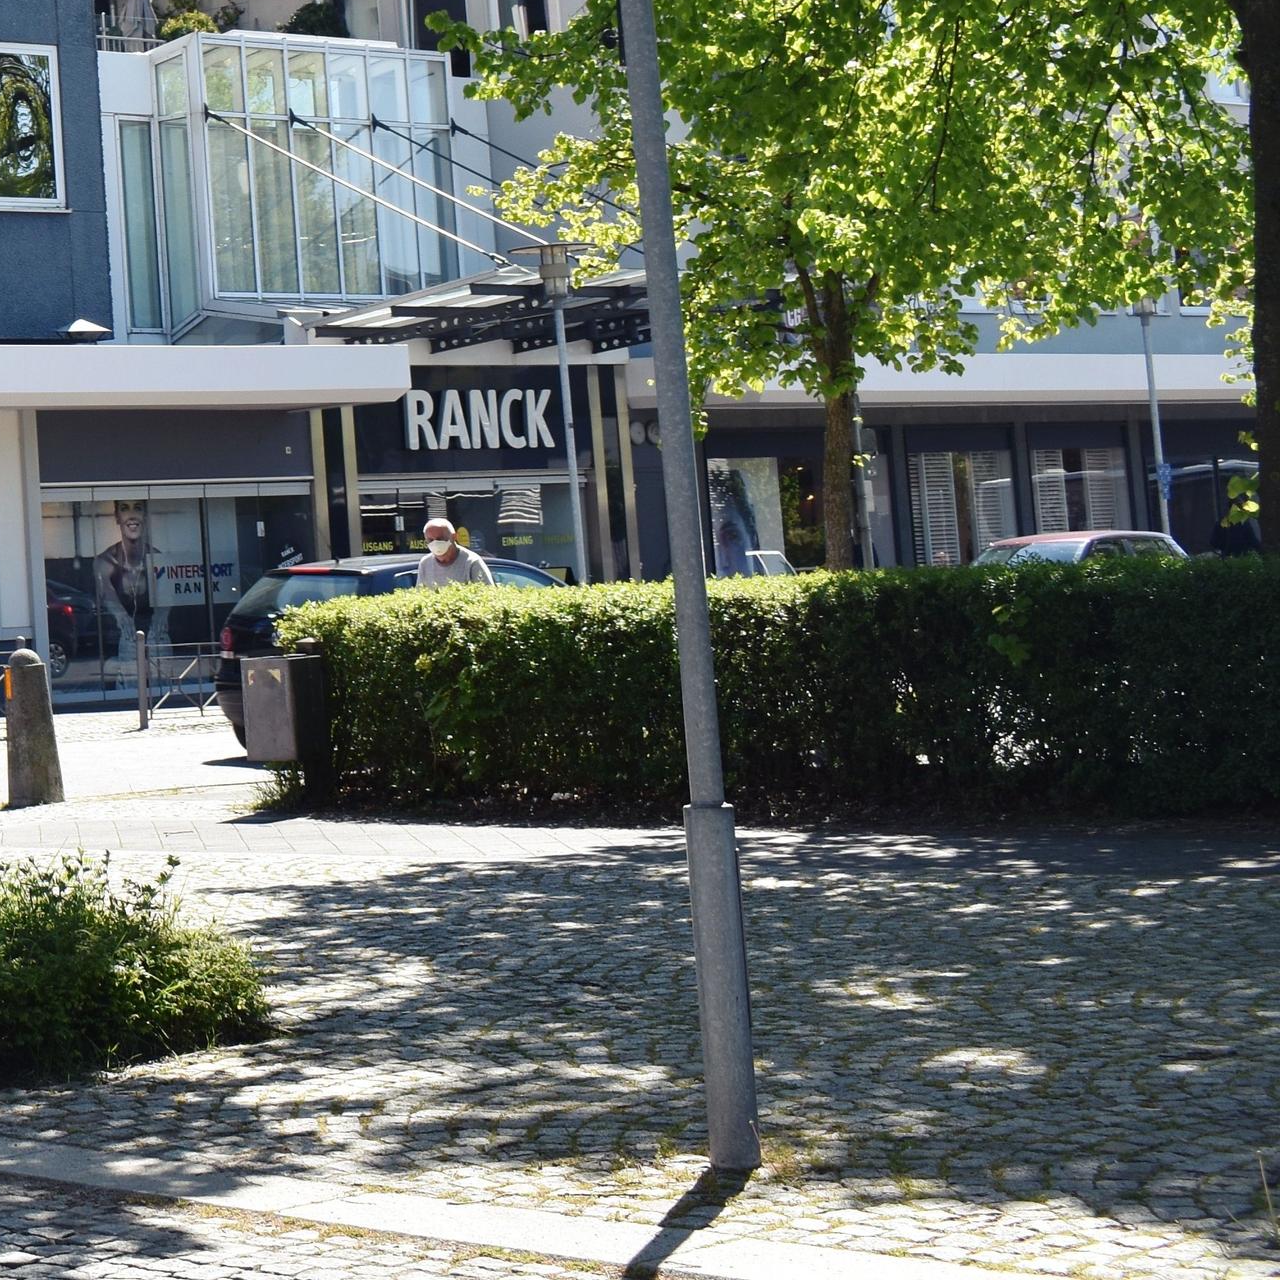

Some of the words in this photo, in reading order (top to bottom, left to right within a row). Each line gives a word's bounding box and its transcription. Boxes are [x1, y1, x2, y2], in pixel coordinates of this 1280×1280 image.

[406, 389, 555, 450] RANCK
[362, 541, 394, 552] USGANG
[409, 538, 429, 550] AUSG
[502, 535, 534, 546] EINGANG
[167, 563, 233, 579] INTERSORT
[174, 581, 220, 594] RANK
